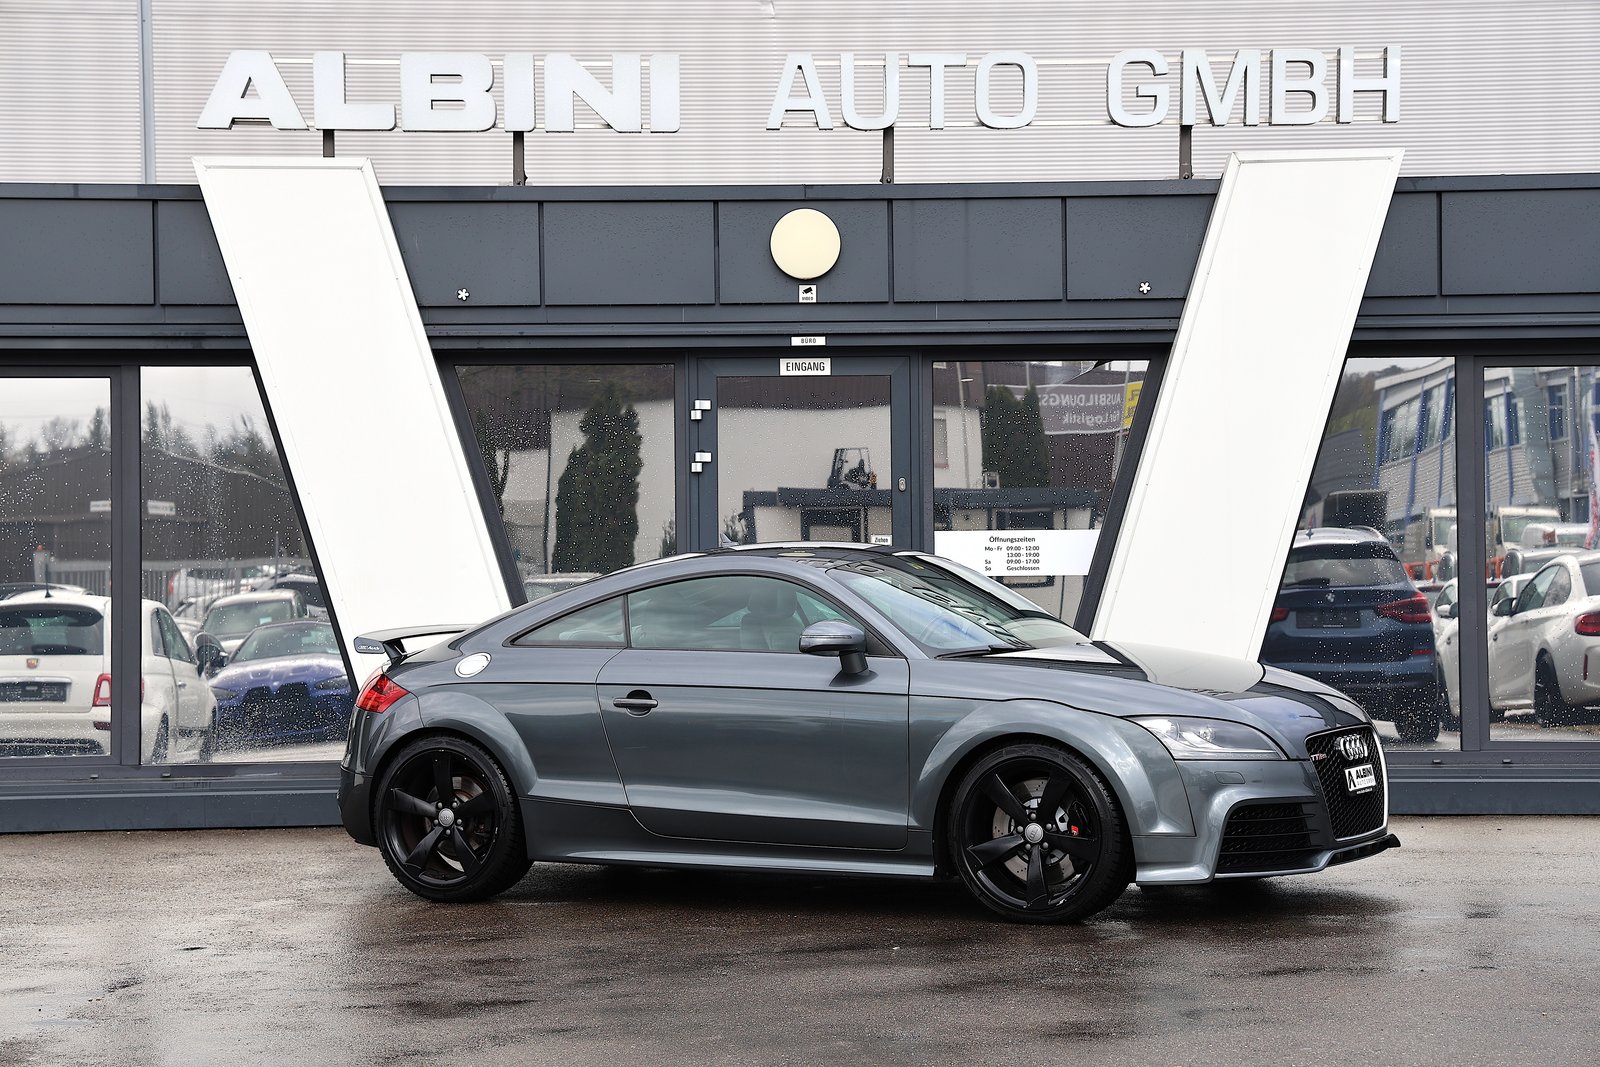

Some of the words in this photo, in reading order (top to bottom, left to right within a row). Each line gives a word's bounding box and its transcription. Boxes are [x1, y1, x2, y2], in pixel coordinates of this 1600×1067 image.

[196, 50, 681, 134] ALBINI
[766, 50, 1039, 130] AUTO
[1106, 45, 1402, 128] GMBH
[786, 361, 825, 372] EINGANG
[989, 535, 1036, 543] Öffnungszeiten
